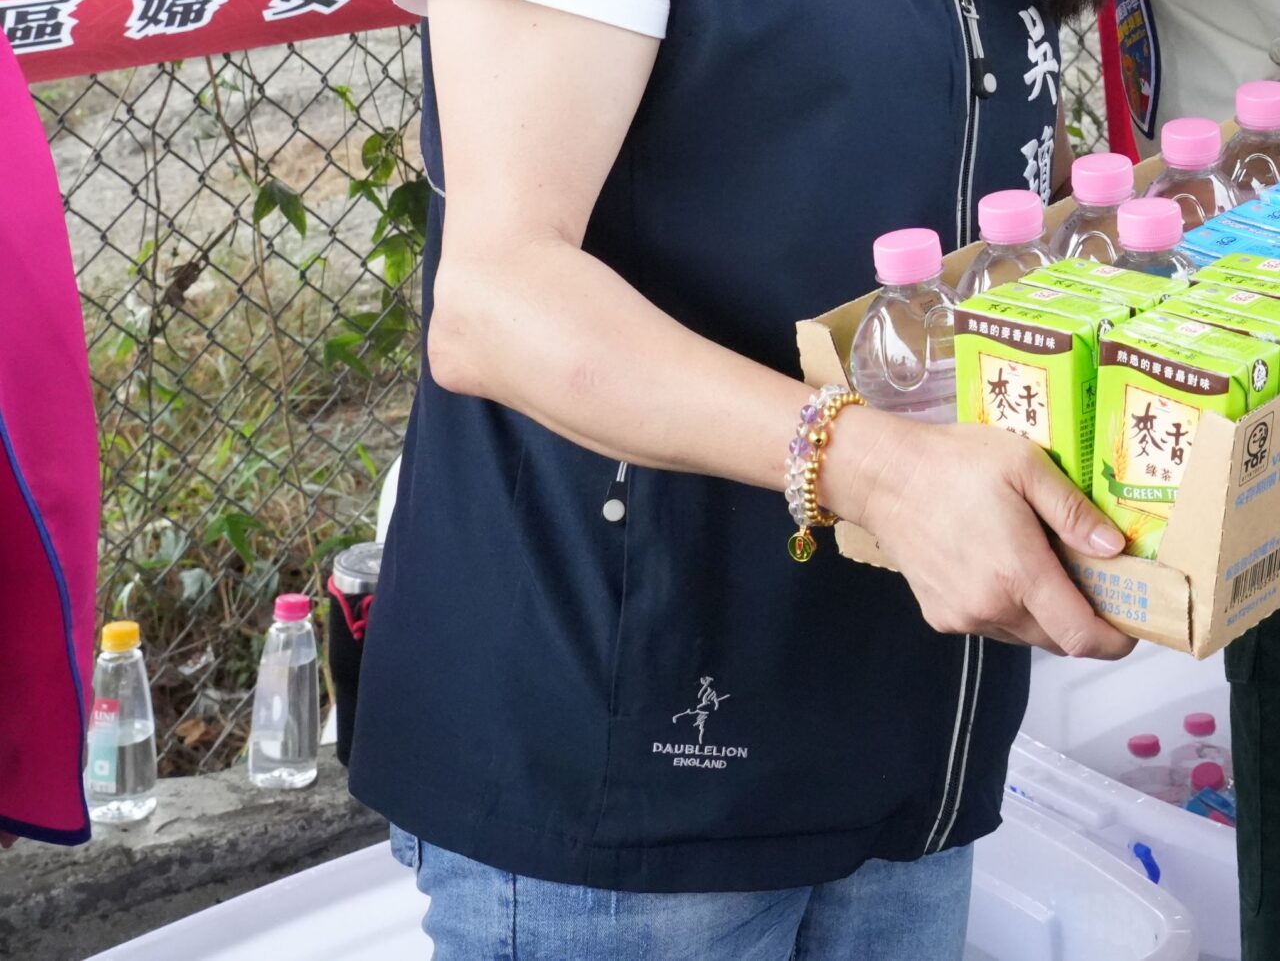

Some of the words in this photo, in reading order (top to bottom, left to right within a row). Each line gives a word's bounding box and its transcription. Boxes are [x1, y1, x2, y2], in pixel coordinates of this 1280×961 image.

[968, 318, 1056, 349] 熟悉的麥香最對味
[1116, 349, 1211, 391] 熟悉的麥香最對味
[986, 367, 1046, 427] 麥香
[1145, 462, 1173, 483] 綠茶
[1243, 449, 1268, 474] TQF
[1122, 486, 1163, 500] GREEN
[652, 742, 748, 758] DAUBLELION
[673, 757, 727, 769] ENGLAND
